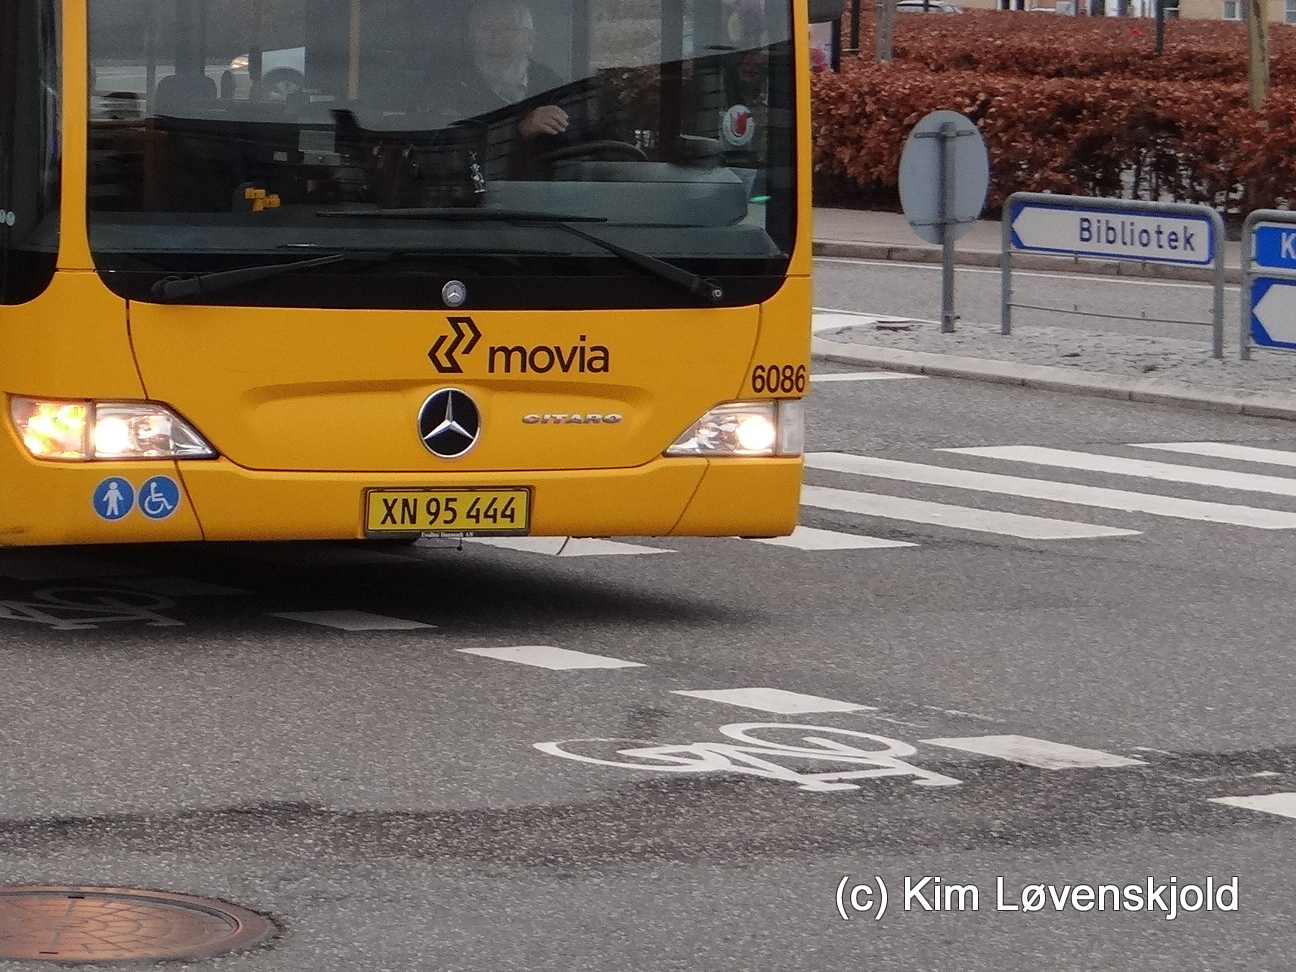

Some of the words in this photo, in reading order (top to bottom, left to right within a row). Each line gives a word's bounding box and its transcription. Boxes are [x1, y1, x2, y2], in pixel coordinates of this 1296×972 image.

[1079, 217, 1195, 252] Bibliotek
[488, 335, 610, 373] movia
[751, 364, 806, 394] 6086
[522, 412, 622, 425] CITARO
[380, 497, 418, 525] XN
[425, 497, 458, 526] 95
[466, 496, 516, 524] 444
